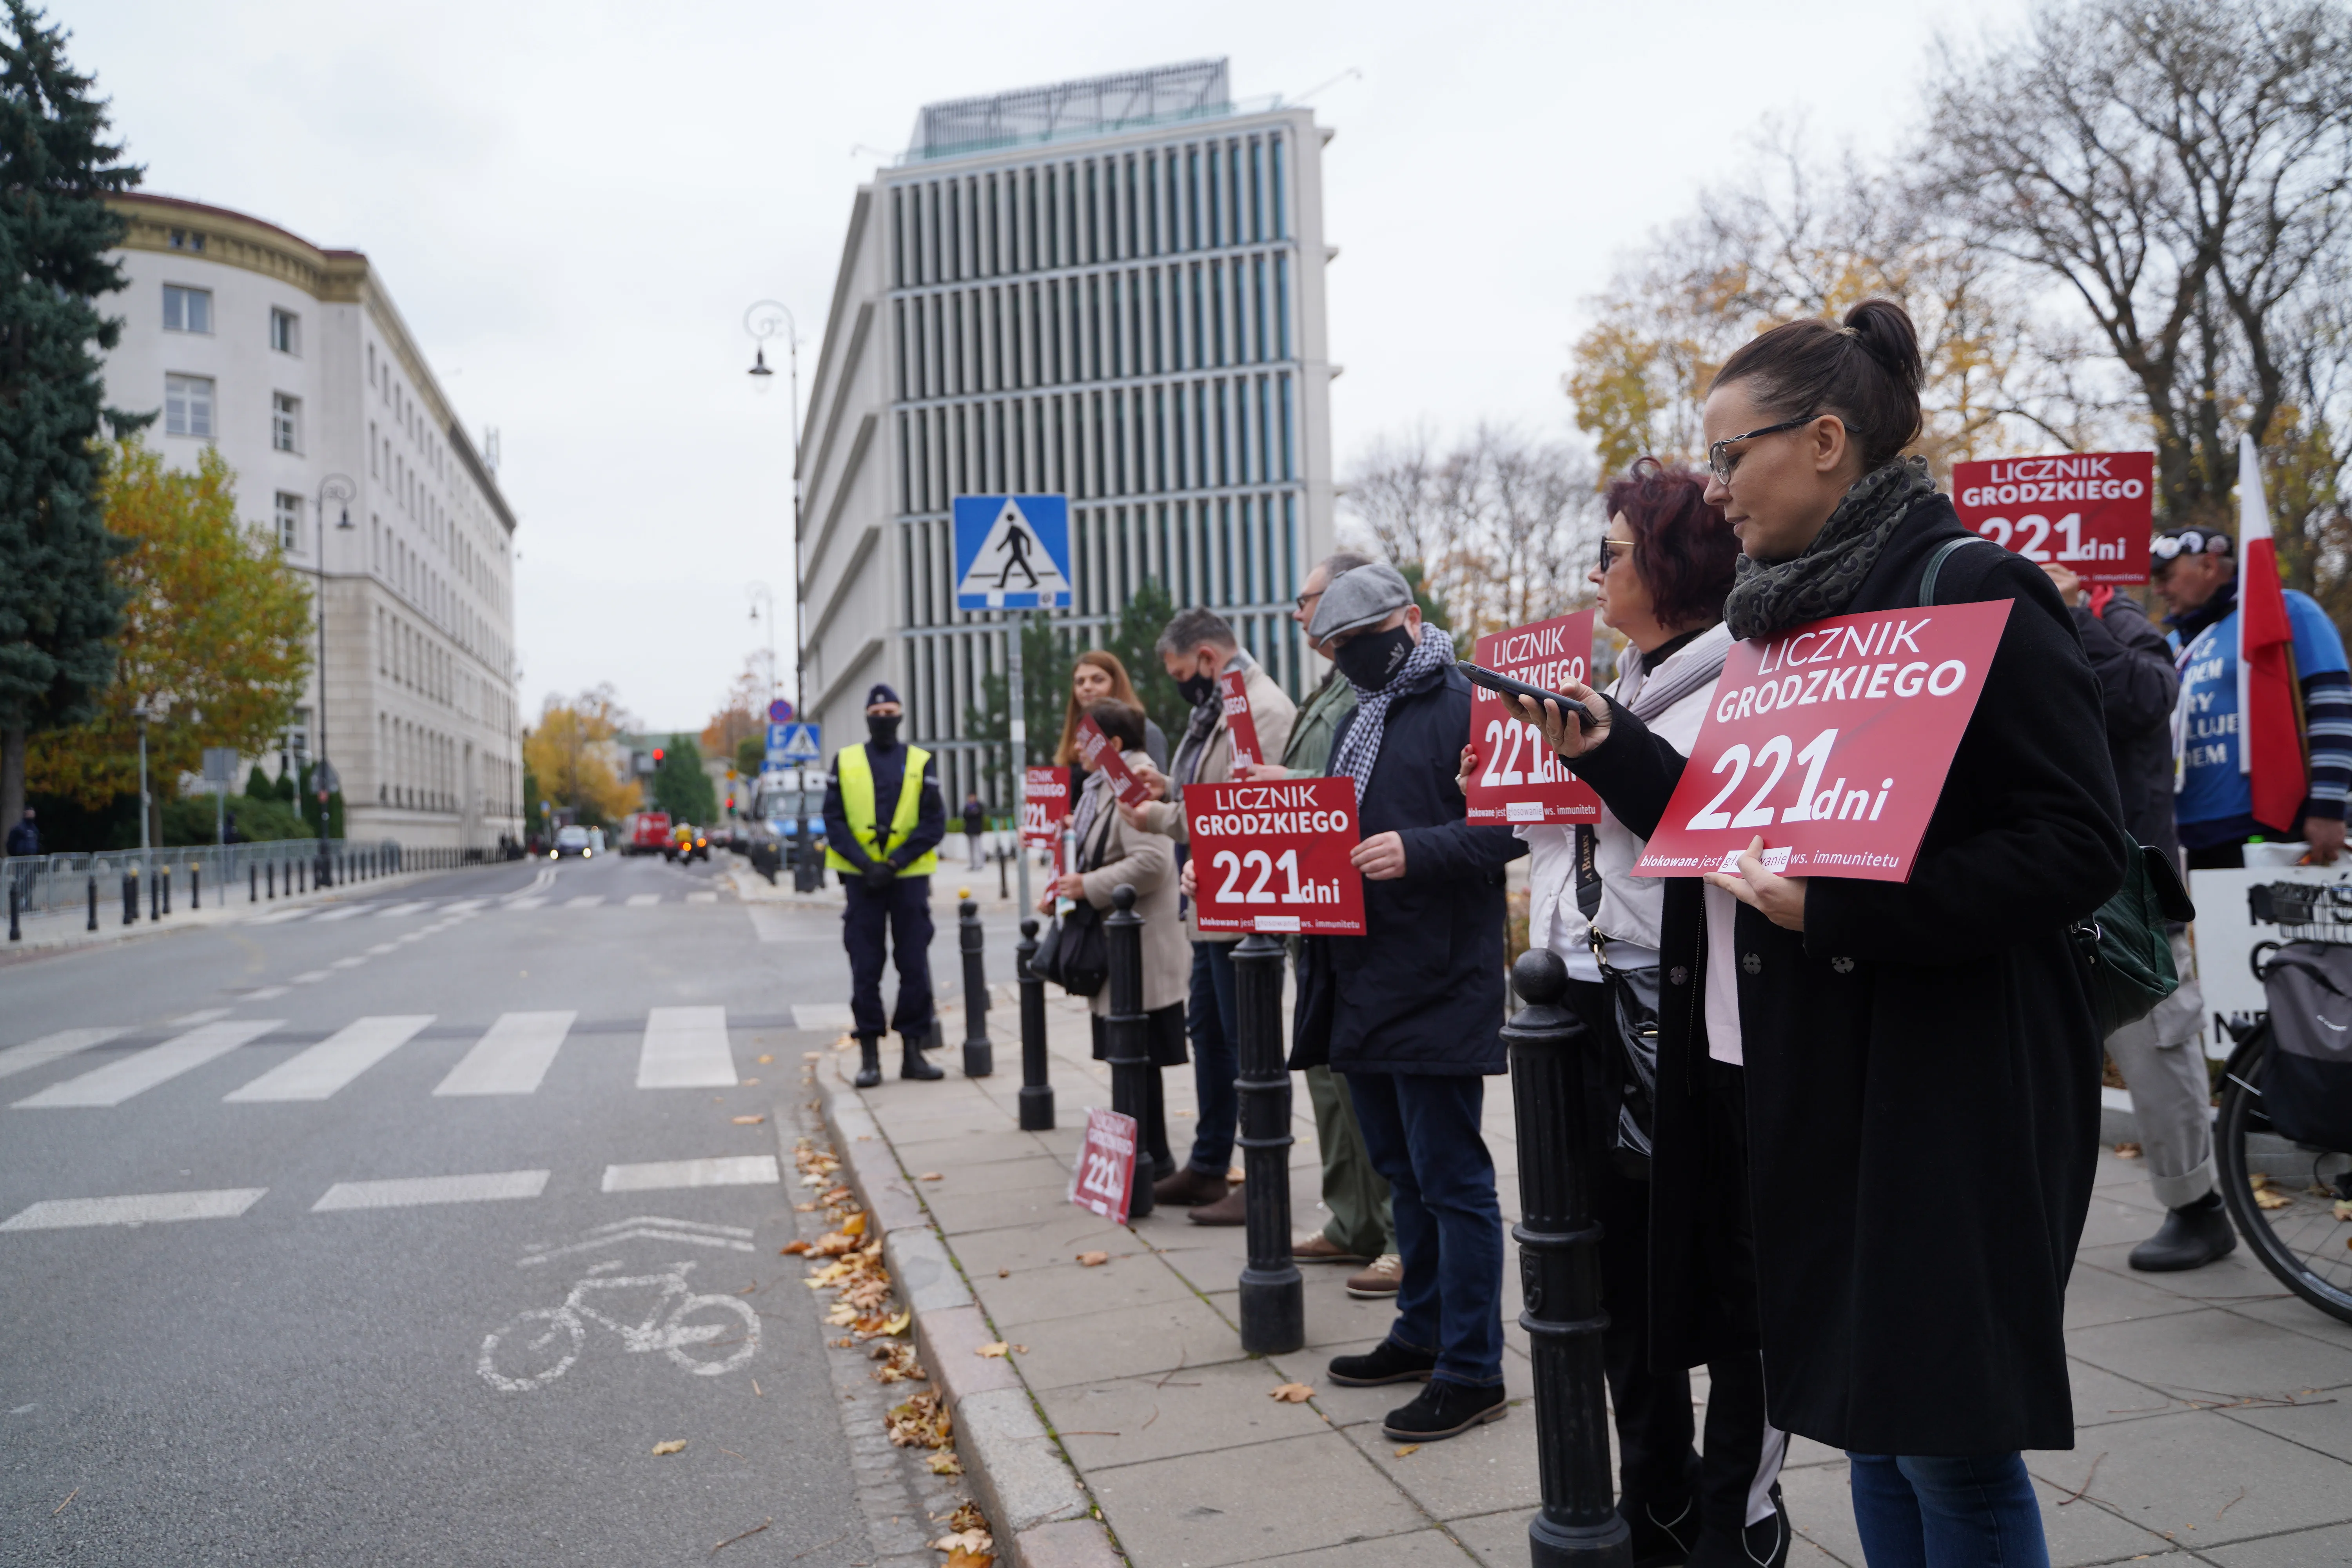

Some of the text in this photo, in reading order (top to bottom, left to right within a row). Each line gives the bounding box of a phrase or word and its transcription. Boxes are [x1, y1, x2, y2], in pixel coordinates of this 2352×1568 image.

[1991, 457, 2112, 483] LICZNIK
[1962, 478, 2144, 507] GRODZKIEGO
[1493, 625, 1566, 667] LICZNIK
[1758, 618, 1932, 675] LICZNIK
[1477, 656, 1584, 702] GZKIEGO
[1716, 660, 1966, 723] GRODZKIEGO
[1215, 785, 1318, 810] LICZNIK
[1195, 810, 1348, 836] GRODZKIEGO
[1468, 804, 1596, 818] blokowane jest głosowanie ws. immunitetu
[1640, 849, 1900, 869] blokowane jest głwanie ws. immunitetu
[1200, 917, 1239, 927] blokowane
[1240, 918, 1254, 928] jest
[1315, 919, 1360, 929] immunitetu
